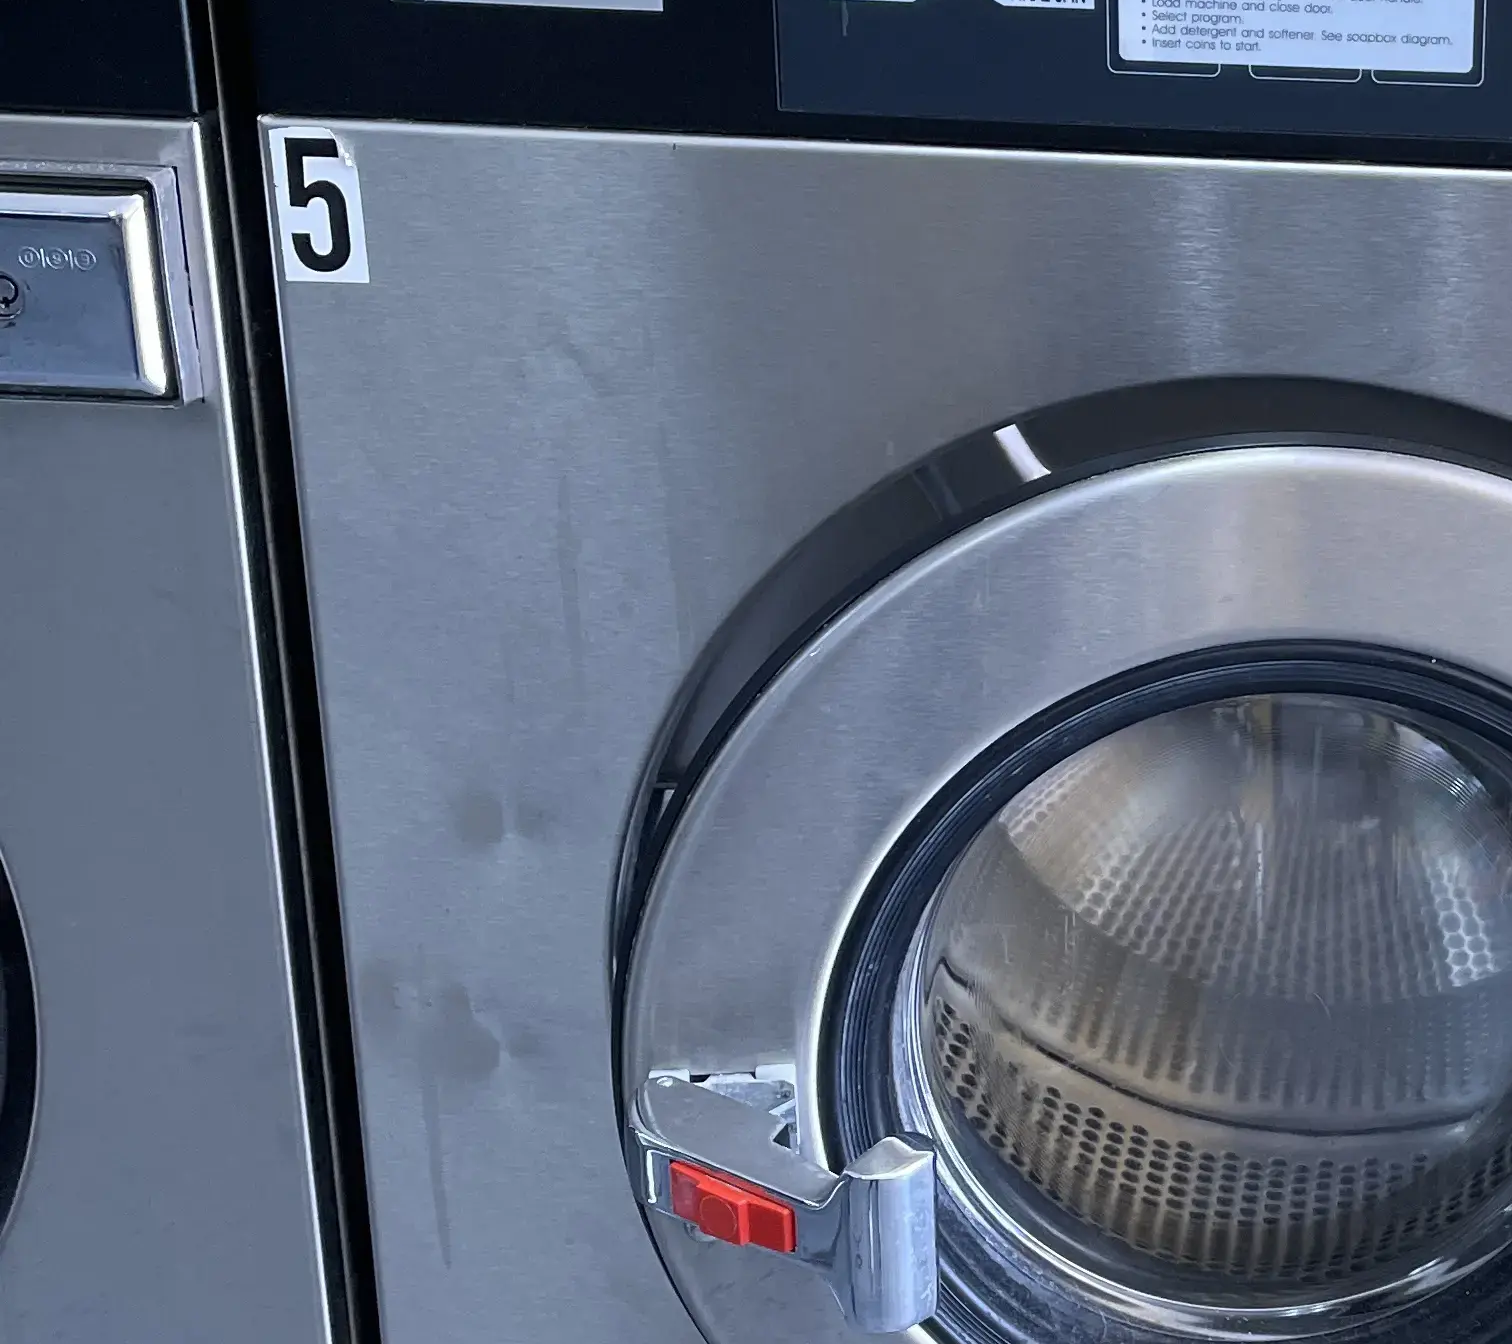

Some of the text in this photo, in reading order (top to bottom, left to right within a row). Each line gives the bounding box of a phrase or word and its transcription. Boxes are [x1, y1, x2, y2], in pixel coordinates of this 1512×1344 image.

[1241, 0, 1266, 12] and
[1269, 2, 1300, 14] close
[1303, 3, 1333, 15] door.
[1151, 9, 1245, 26] Select program.
[1151, 23, 1176, 36] Add
[1180, 25, 1238, 39] detergent
[1241, 28, 1265, 39] and
[1320, 30, 1343, 42] See
[1346, 31, 1398, 46] soapbox
[1400, 33, 1454, 48] diagram.
[1152, 37, 1262, 52] Insert coins to start.
[283, 136, 353, 274] 5
